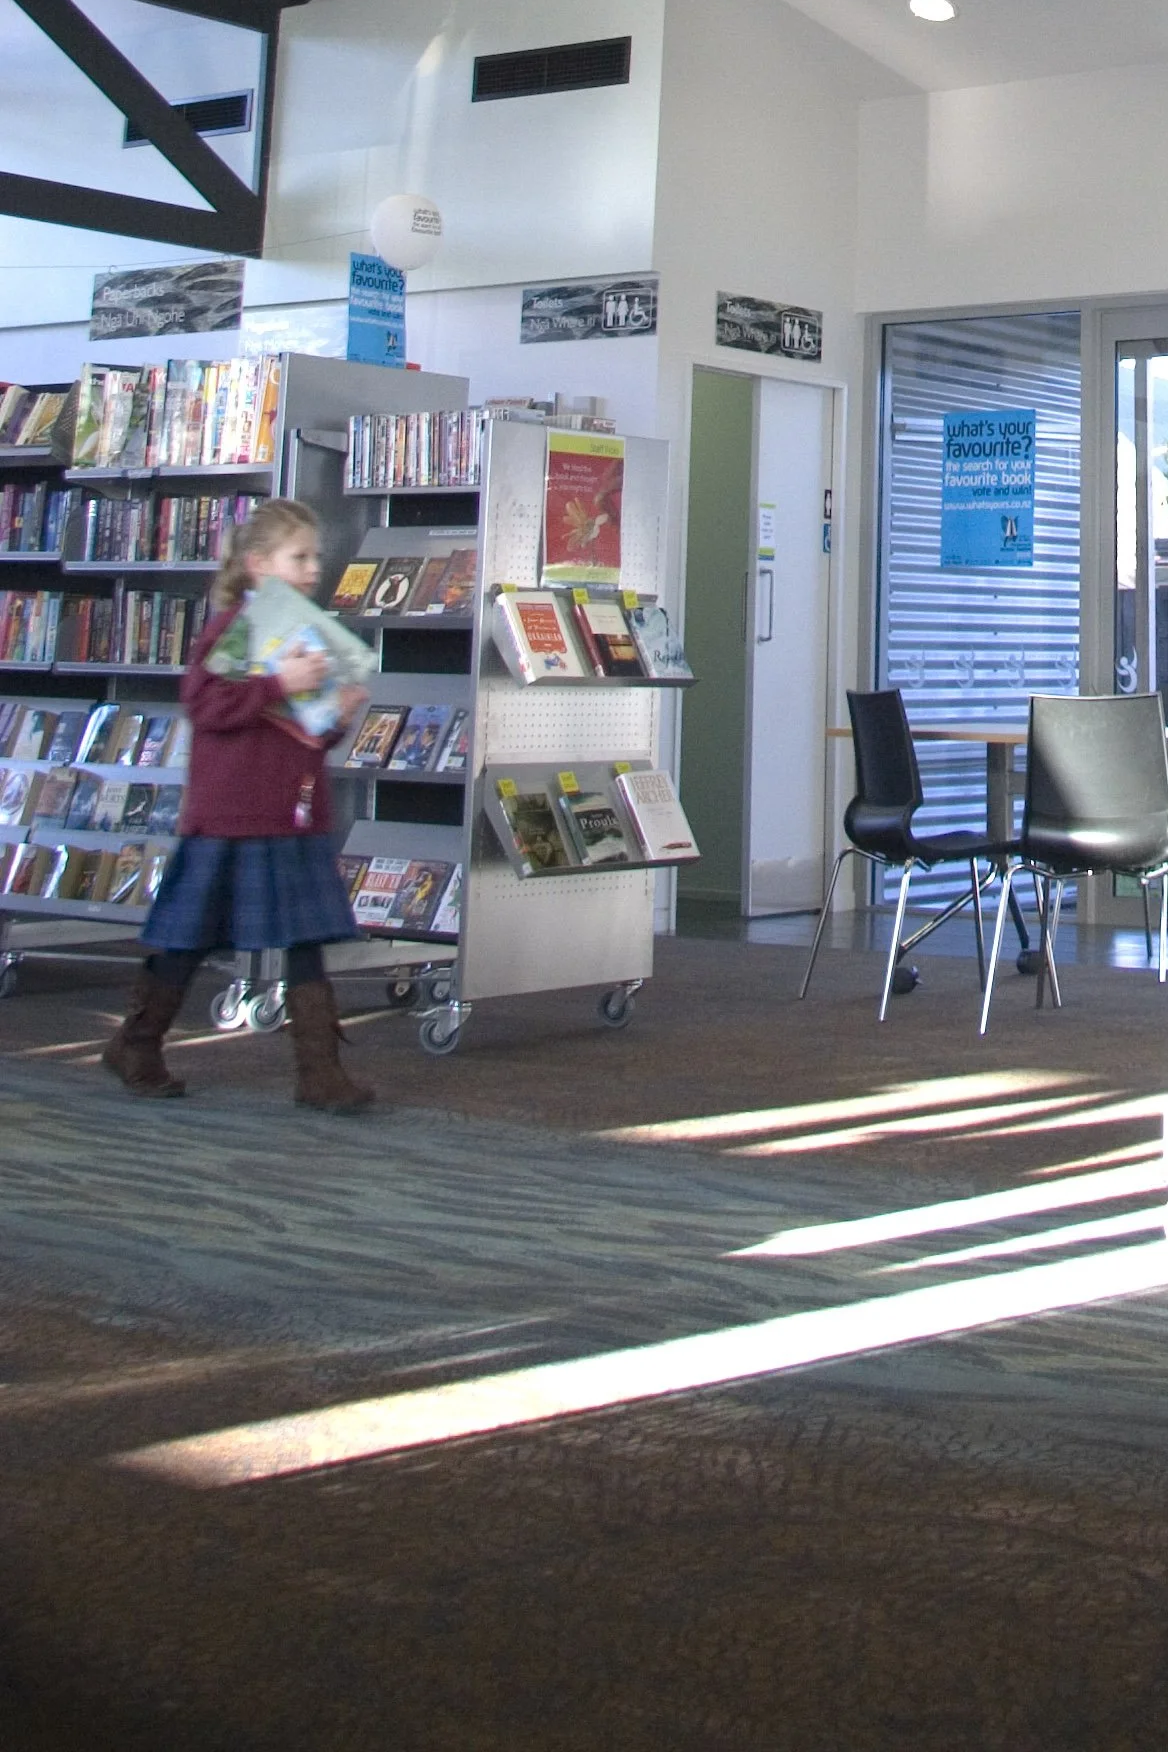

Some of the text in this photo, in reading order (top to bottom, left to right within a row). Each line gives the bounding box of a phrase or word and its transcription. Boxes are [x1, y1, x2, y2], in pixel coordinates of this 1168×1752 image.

[352, 259, 382, 277] what's
[351, 270, 405, 296] favourite?
[102, 282, 165, 304] Paperbacks
[531, 296, 563, 309] Toilets
[946, 420, 1032, 439] what's your
[945, 435, 1033, 460] favourite?
[945, 459, 1032, 474] the search for your
[944, 471, 1032, 488] favourite book
[971, 485, 1032, 497] vote and win!
